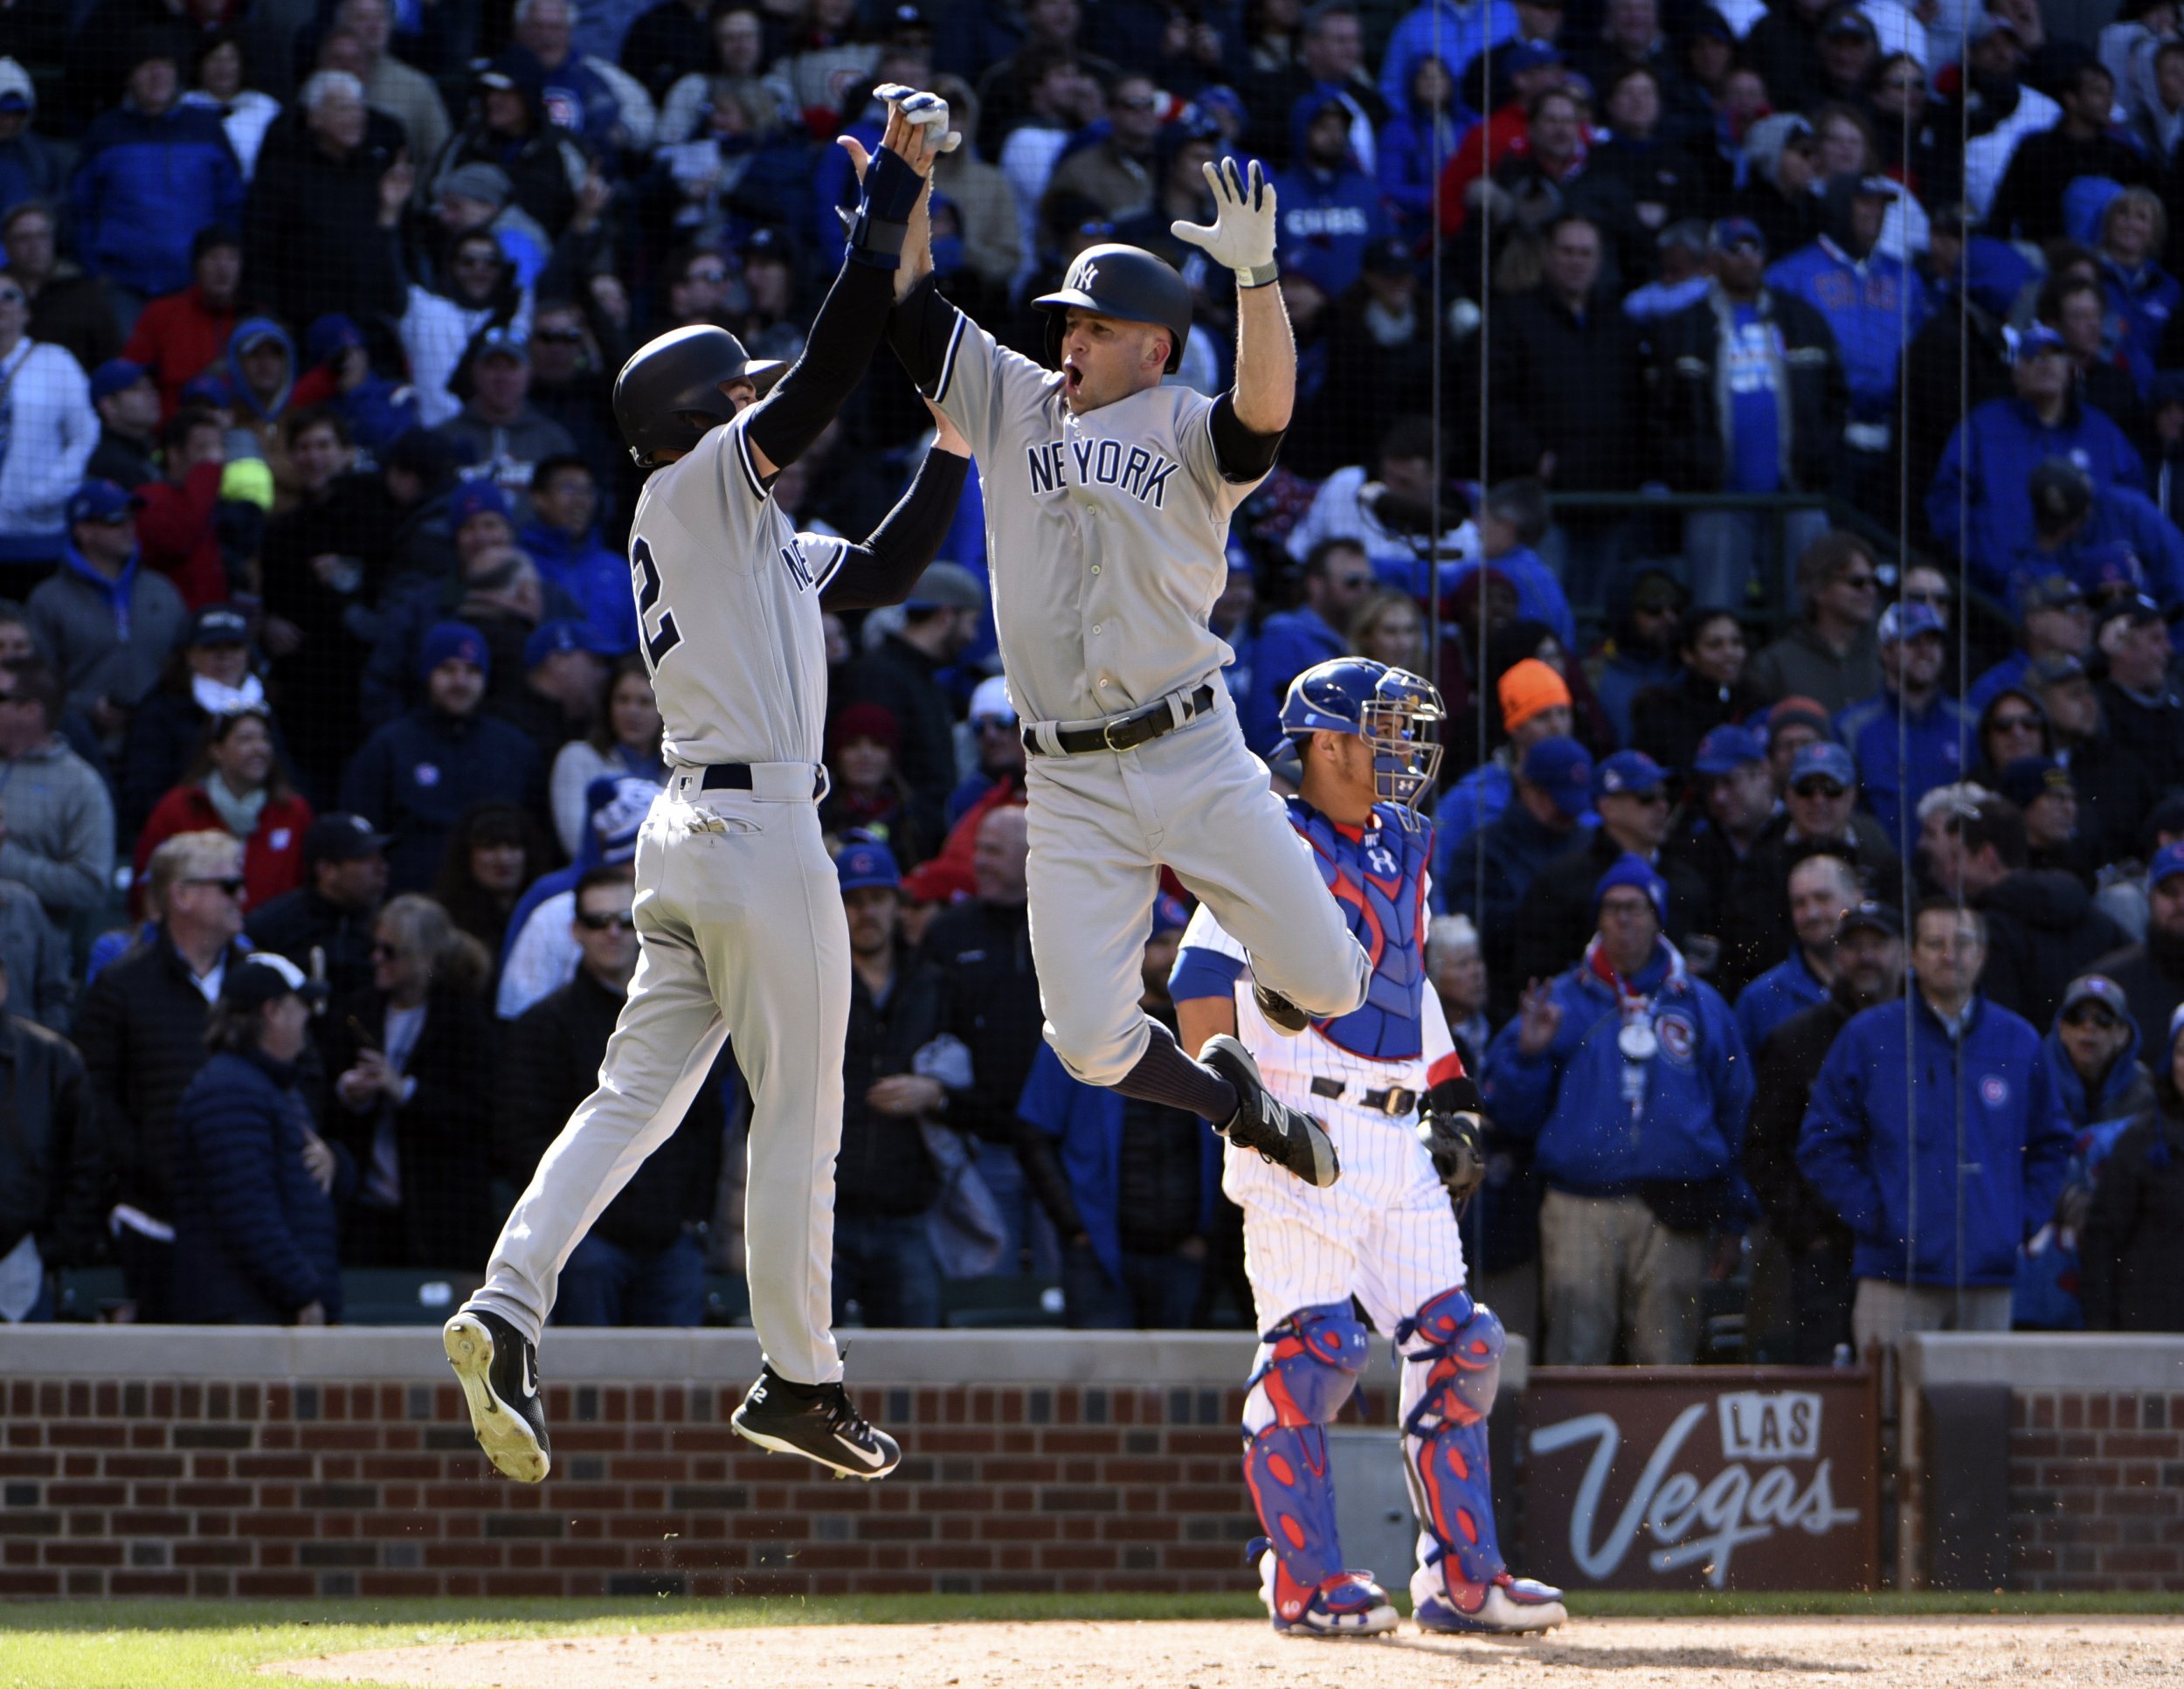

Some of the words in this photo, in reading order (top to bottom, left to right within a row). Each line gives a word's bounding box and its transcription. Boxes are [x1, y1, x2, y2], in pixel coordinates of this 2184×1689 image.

[1071, 262, 1099, 290] NY
[1070, 438, 1181, 510] YORK
[1731, 1401, 1810, 1450] LAS
[1529, 1402, 1861, 1589] Vegas
